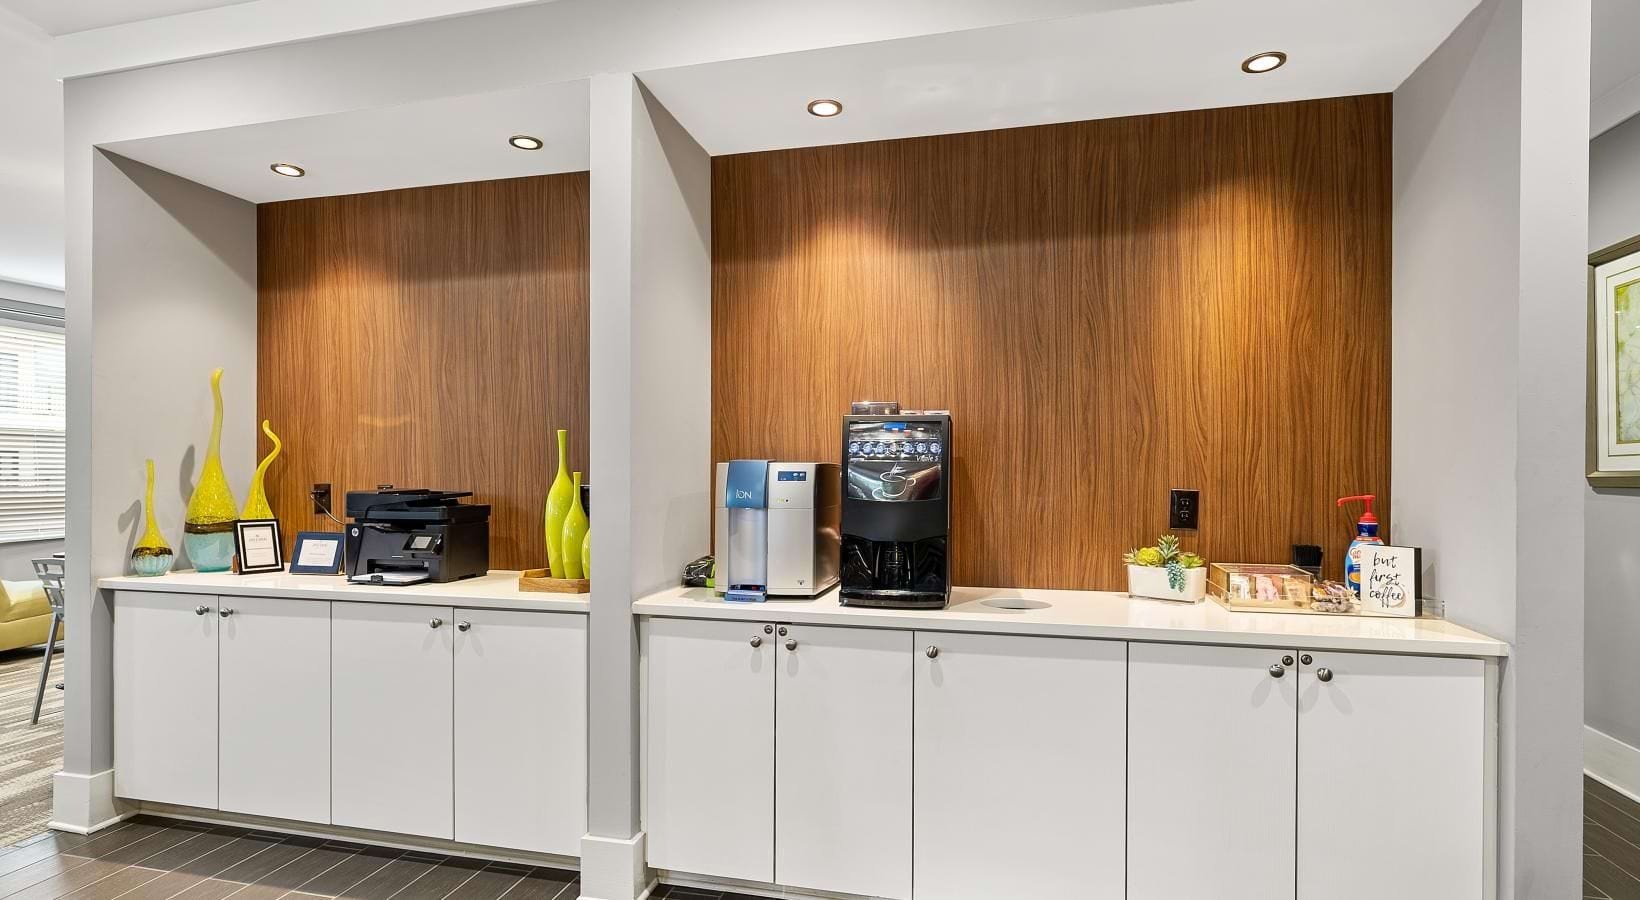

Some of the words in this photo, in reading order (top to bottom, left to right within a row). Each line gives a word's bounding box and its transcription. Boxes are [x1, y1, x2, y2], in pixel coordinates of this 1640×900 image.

[1373, 552, 1399, 568] but
[1369, 568, 1401, 589] first
[1369, 586, 1401, 608] coffee
